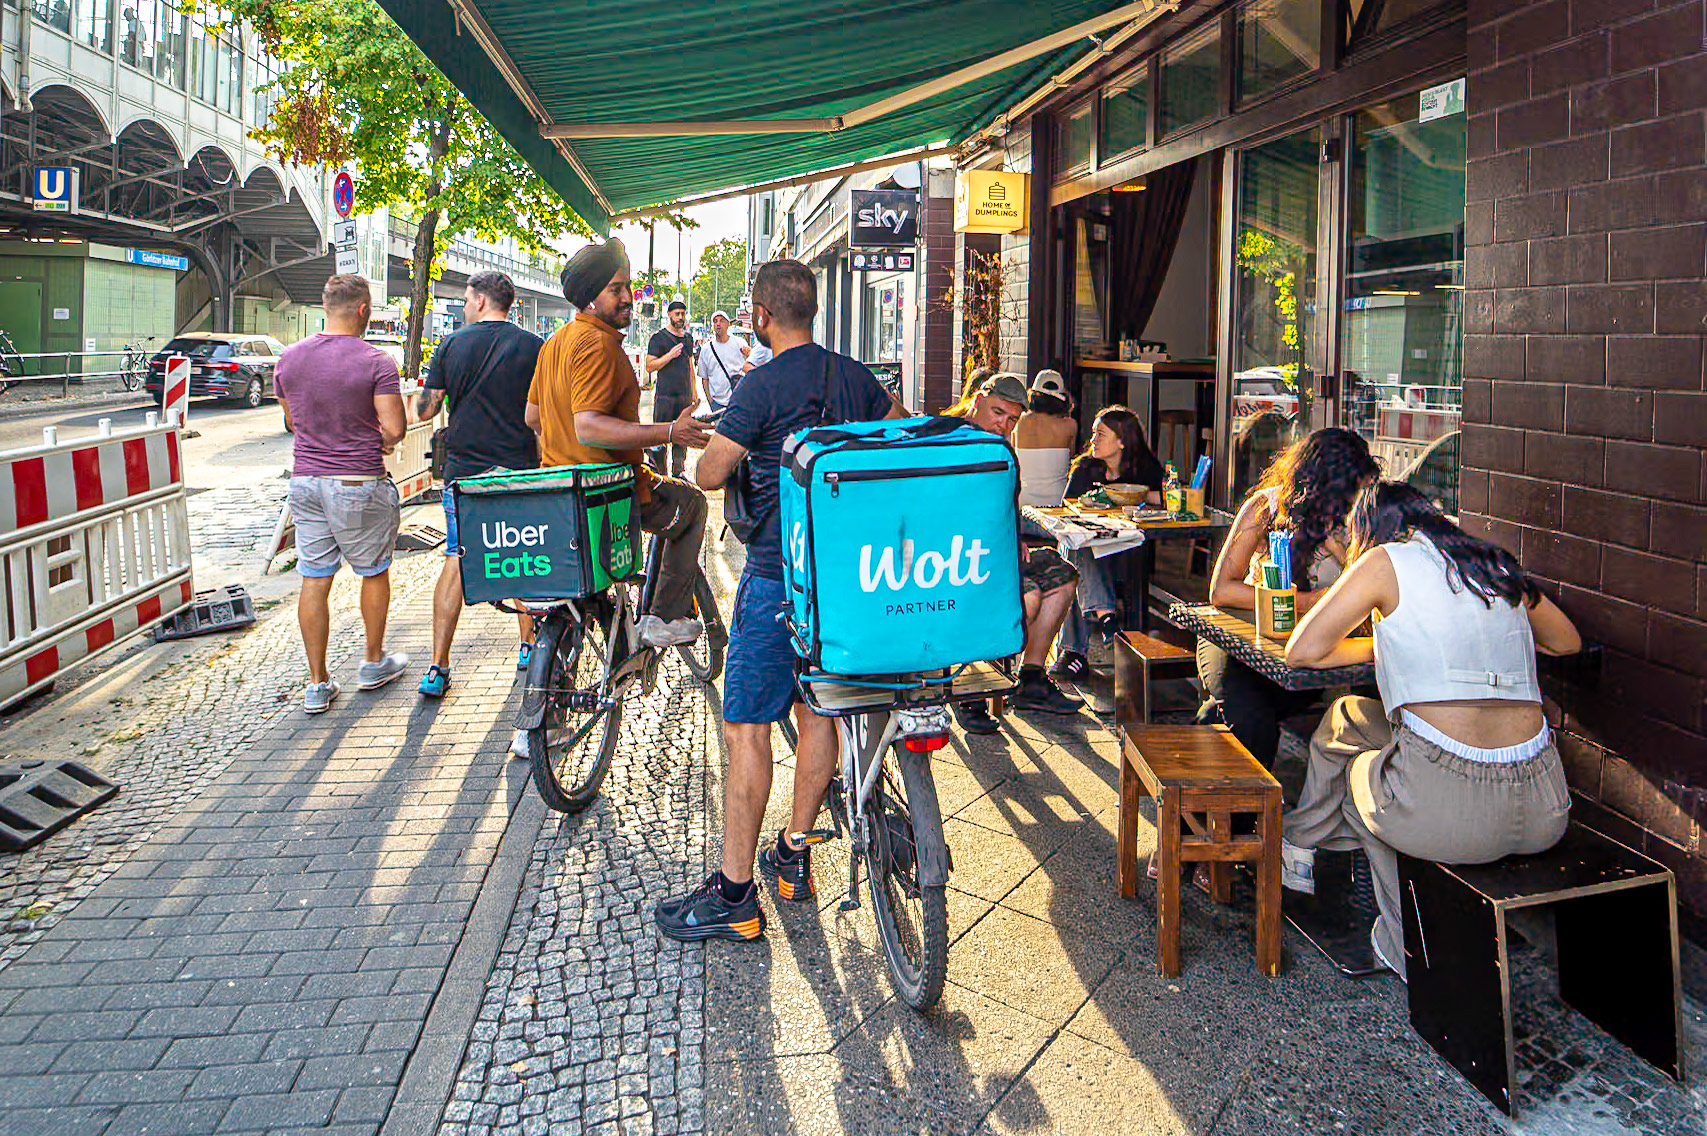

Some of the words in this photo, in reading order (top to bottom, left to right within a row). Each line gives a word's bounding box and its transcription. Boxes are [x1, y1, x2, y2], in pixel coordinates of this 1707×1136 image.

[39, 169, 65, 199] U
[858, 202, 909, 234] sky
[975, 208, 1018, 218] DUMPLINGS
[982, 201, 1004, 209] HOME
[481, 521, 549, 549] Uber
[483, 551, 552, 579] Eats
[859, 535, 991, 593] Wolt
[886, 599, 957, 616] PARTNER
